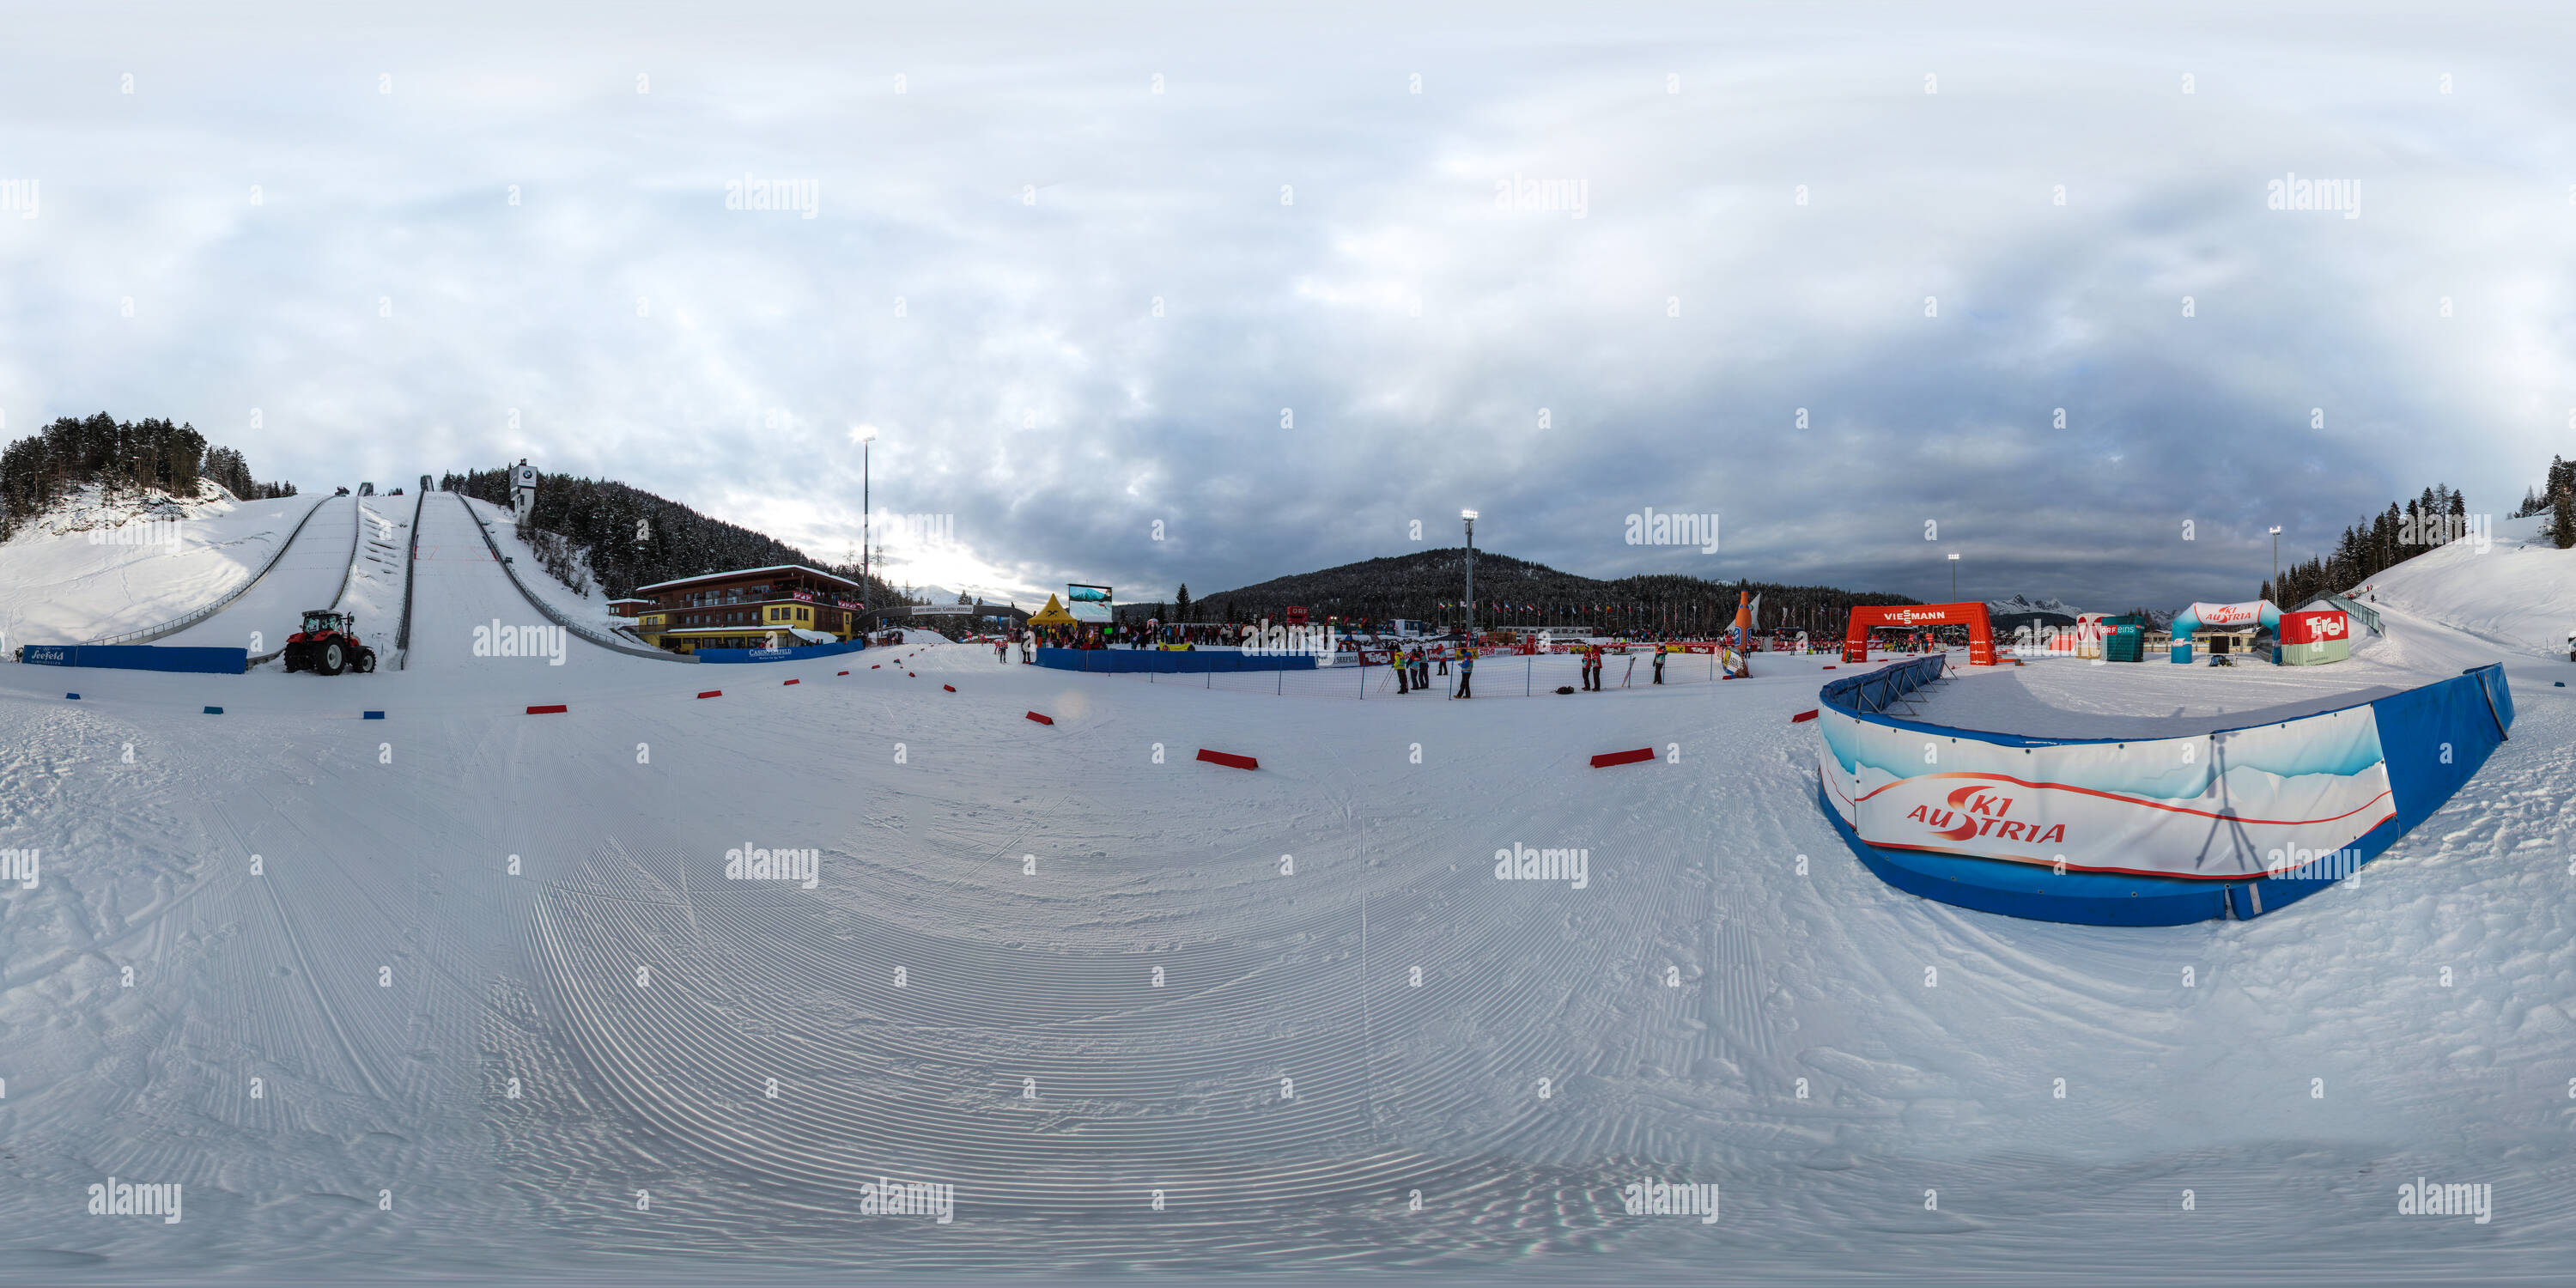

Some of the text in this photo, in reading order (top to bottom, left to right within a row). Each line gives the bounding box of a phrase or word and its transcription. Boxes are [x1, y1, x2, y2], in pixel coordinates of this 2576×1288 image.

[1884, 610, 1945, 624] VIESSMANN
[2306, 616, 2344, 635] Tirol
[1365, 652, 1391, 664] Tirol
[1947, 786, 2014, 817] SKI
[1907, 805, 2066, 844] AUSTRIA
